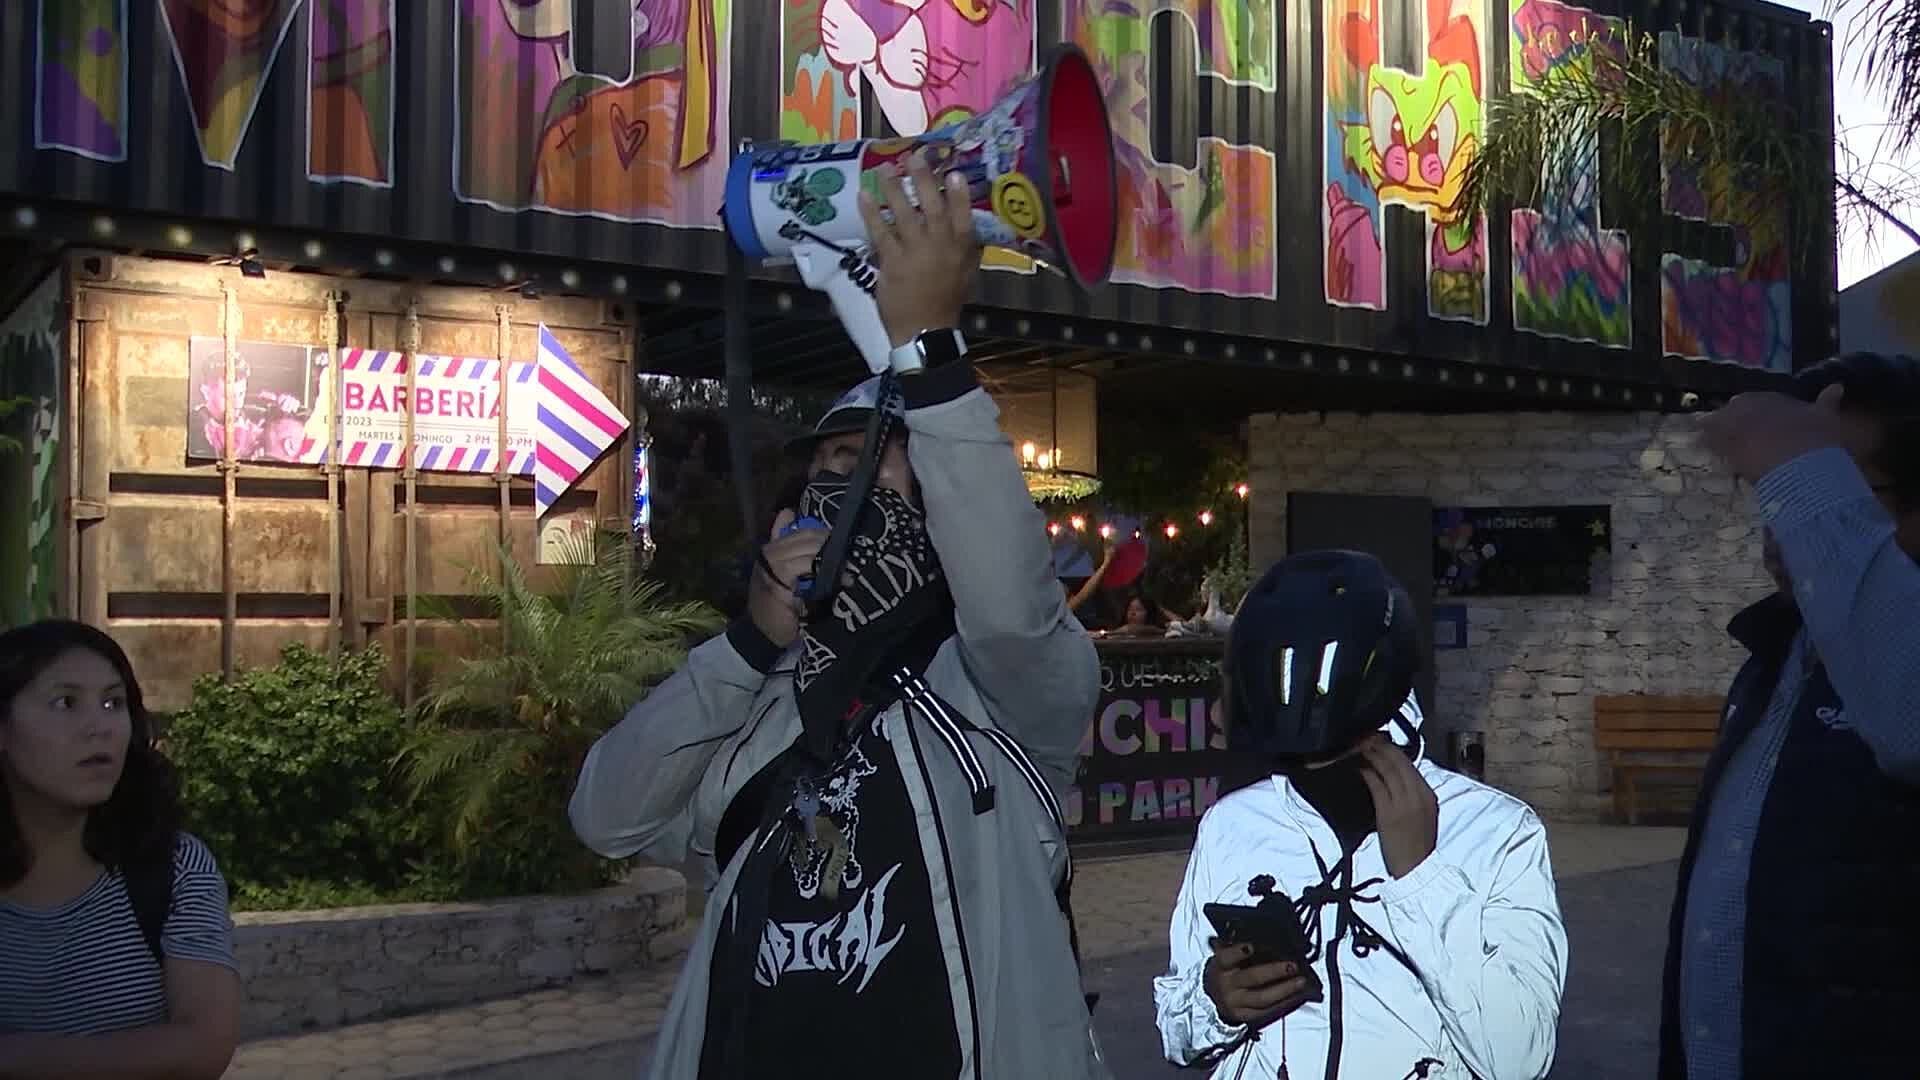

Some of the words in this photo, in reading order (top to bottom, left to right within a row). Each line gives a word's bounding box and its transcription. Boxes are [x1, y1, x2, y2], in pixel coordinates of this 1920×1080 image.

[345, 382, 509, 420] BARBERÍA
[346, 415, 373, 427] 2023
[358, 431, 395, 441] MARTES
[413, 432, 453, 444] OMINGO
[465, 434, 472, 444] 2
[474, 434, 491, 445] PM
[516, 438, 533, 448] PM
